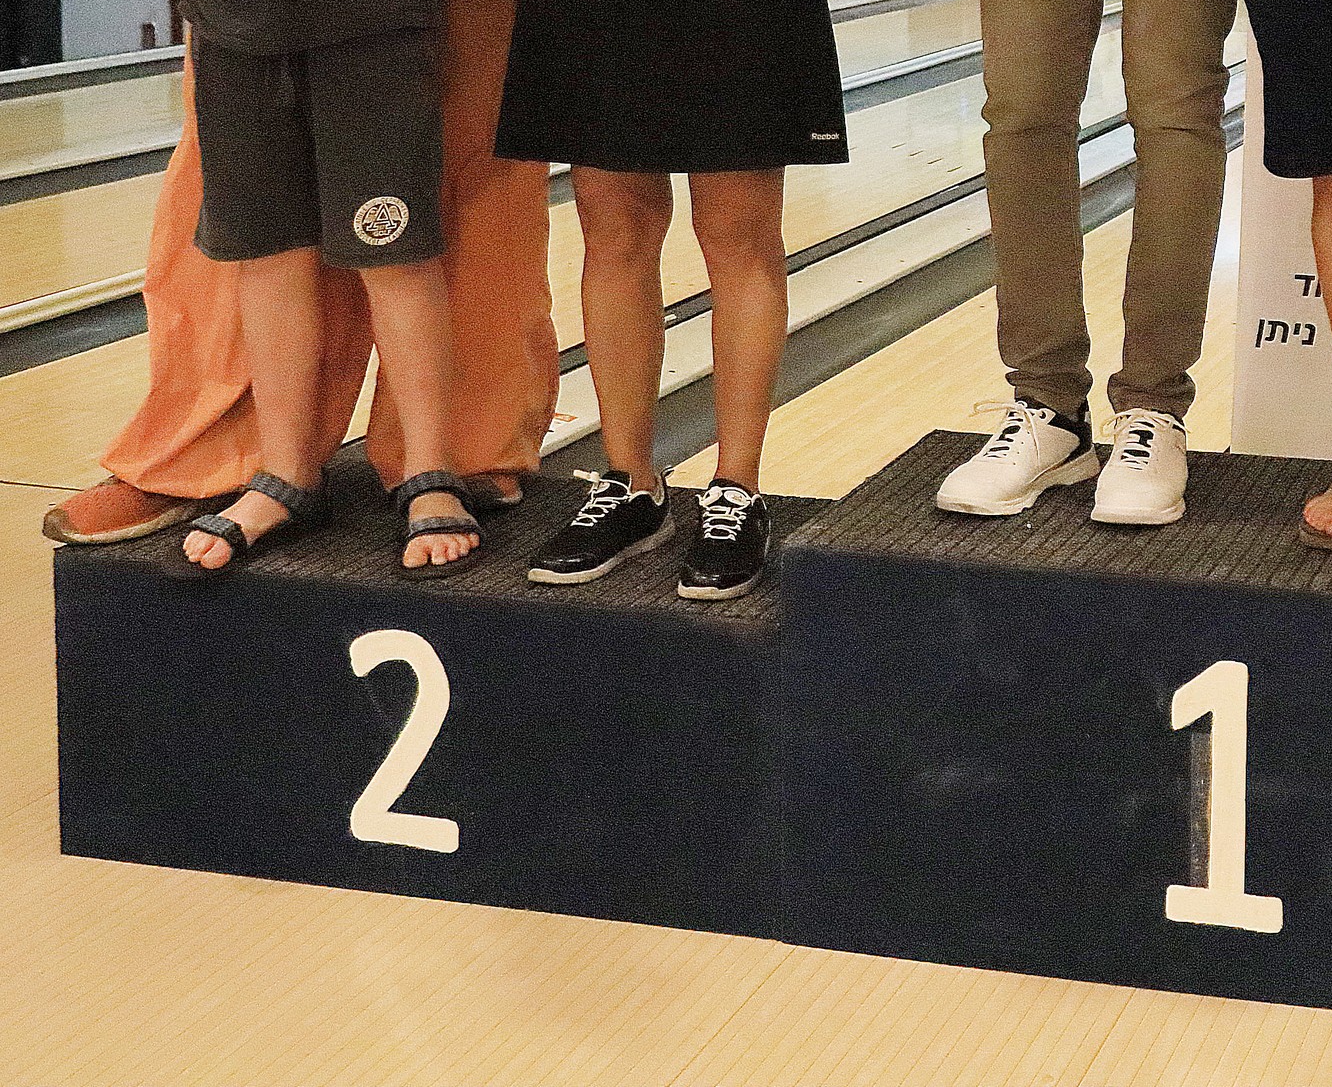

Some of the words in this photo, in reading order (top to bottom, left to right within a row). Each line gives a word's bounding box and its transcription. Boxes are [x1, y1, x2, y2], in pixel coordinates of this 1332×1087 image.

[1255, 319, 1317, 348] ניתן
[349, 629, 459, 853] 2
[1166, 660, 1283, 933] 1
